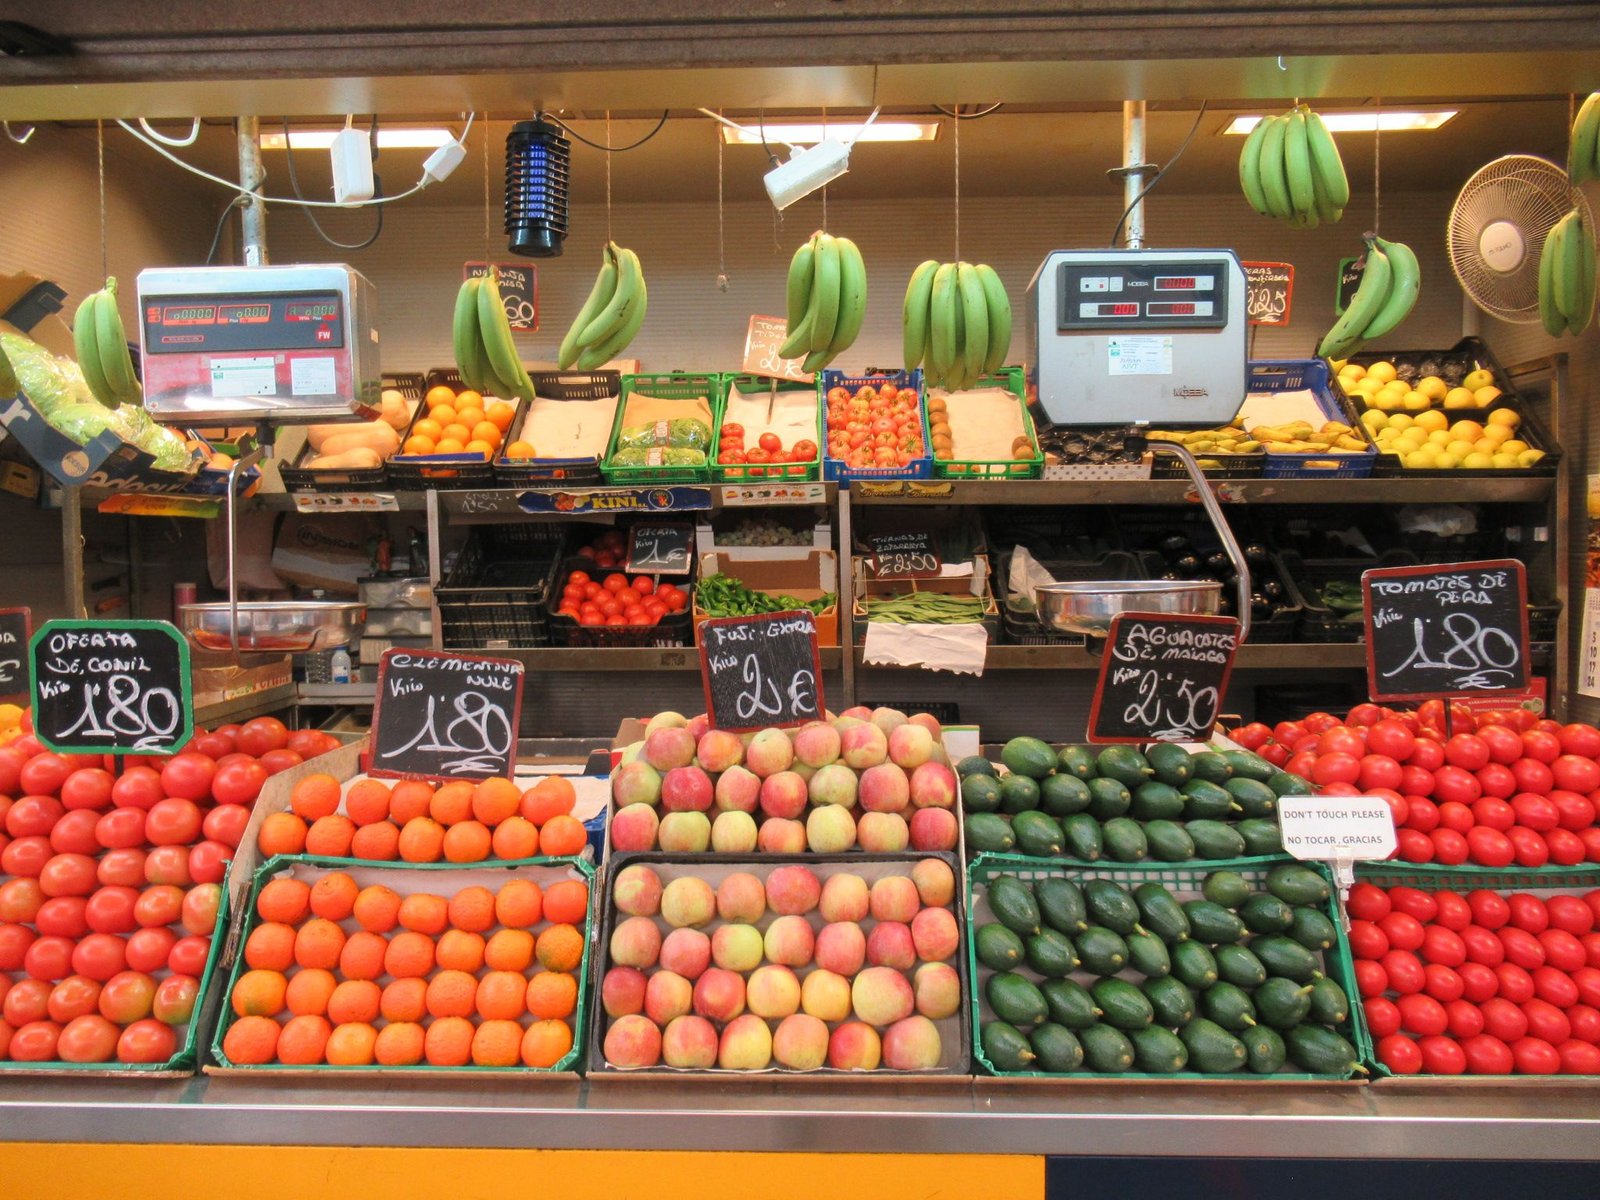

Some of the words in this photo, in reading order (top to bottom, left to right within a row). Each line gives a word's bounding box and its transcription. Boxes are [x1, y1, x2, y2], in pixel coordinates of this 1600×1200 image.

[502, 295, 534, 320] 60
[318, 330, 331, 341] FW
[592, 496, 637, 508] KINI
[636, 539, 669, 565] 1
[666, 547, 686, 562] €
[1371, 575, 1472, 596] TOMATES
[1435, 591, 1493, 606] PERA
[50, 631, 138, 653] OFERTA
[736, 653, 782, 719] 2
[787, 669, 816, 716] €
[1284, 810, 1312, 819] DON'T
[1316, 810, 1348, 819] TOUCH
[1351, 810, 1385, 818] PLEASE
[1287, 836, 1302, 845] NO
[1342, 835, 1383, 845] GRACIAS
